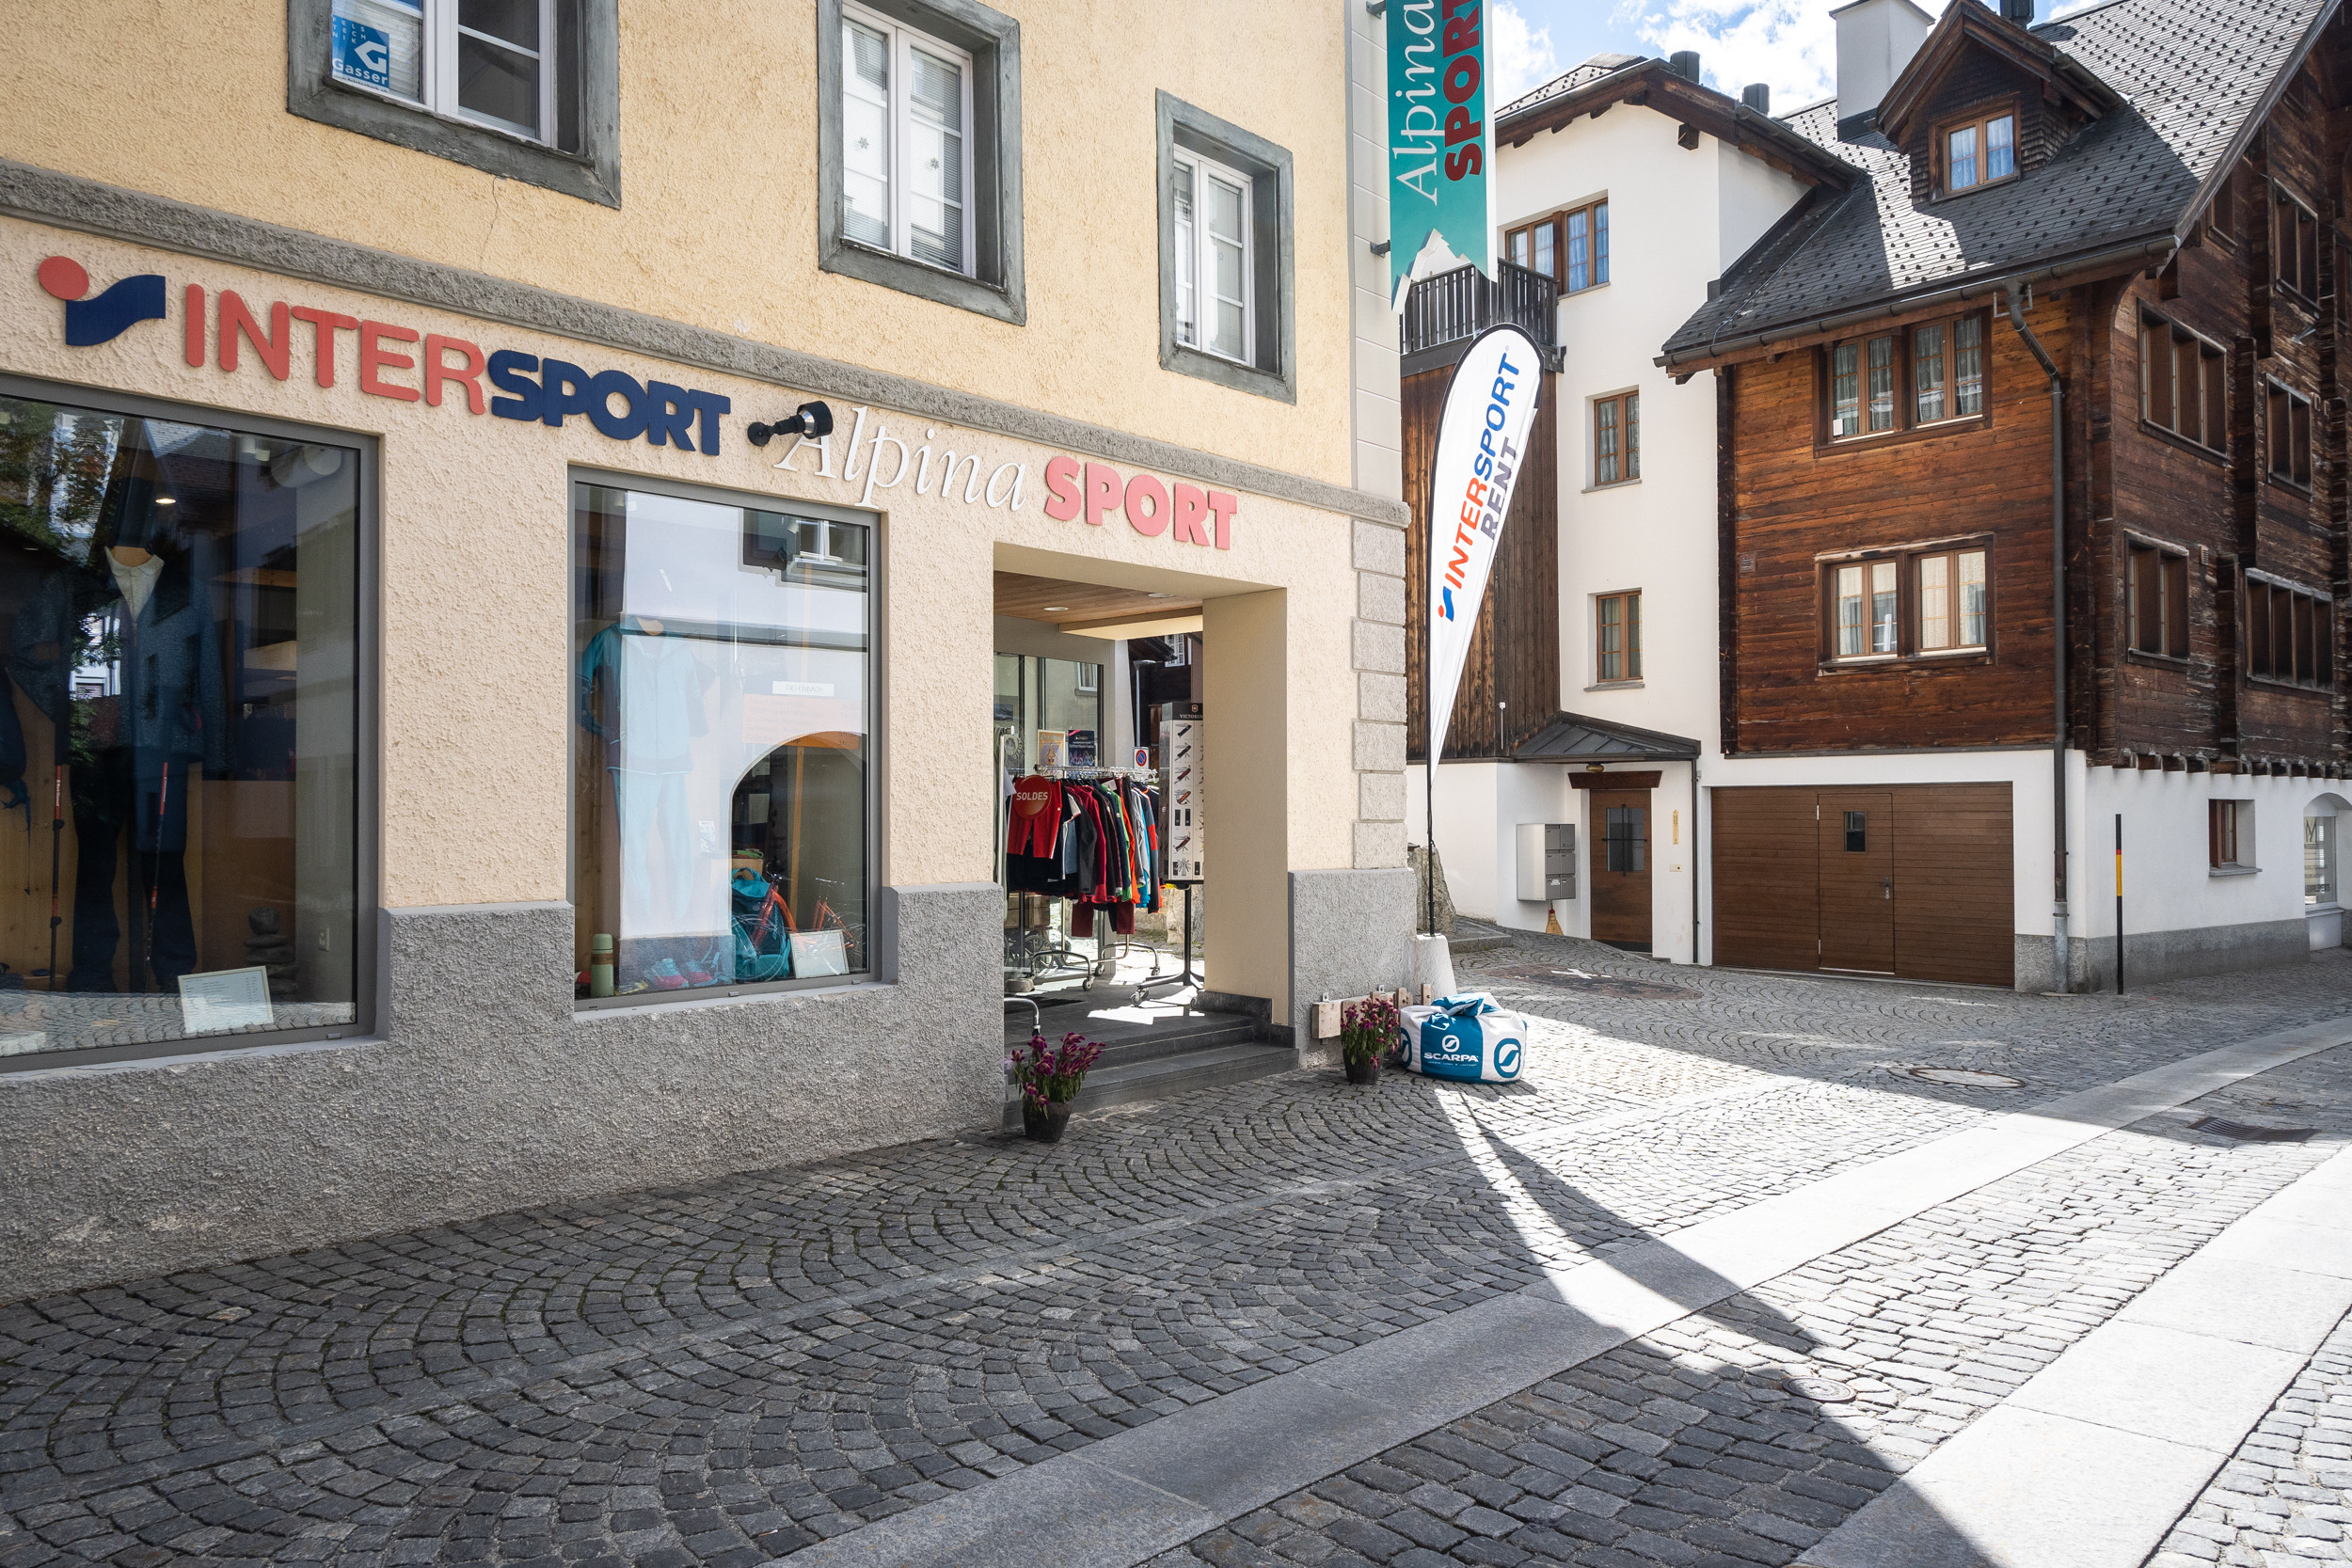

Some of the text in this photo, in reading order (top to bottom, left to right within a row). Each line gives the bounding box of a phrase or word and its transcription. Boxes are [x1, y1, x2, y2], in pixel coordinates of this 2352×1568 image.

[332, 57, 389, 85] Gasser
[1391, 0, 1445, 206] Alpina
[185, 283, 731, 456] INTERSPORT
[772, 406, 1237, 551] Alpina SPORT
[1444, 352, 1520, 590] INTERSPORT
[1480, 436, 1518, 541] RENT
[1016, 791, 1048, 800] SOLDES
[1423, 1052, 1479, 1062] SCARPA
